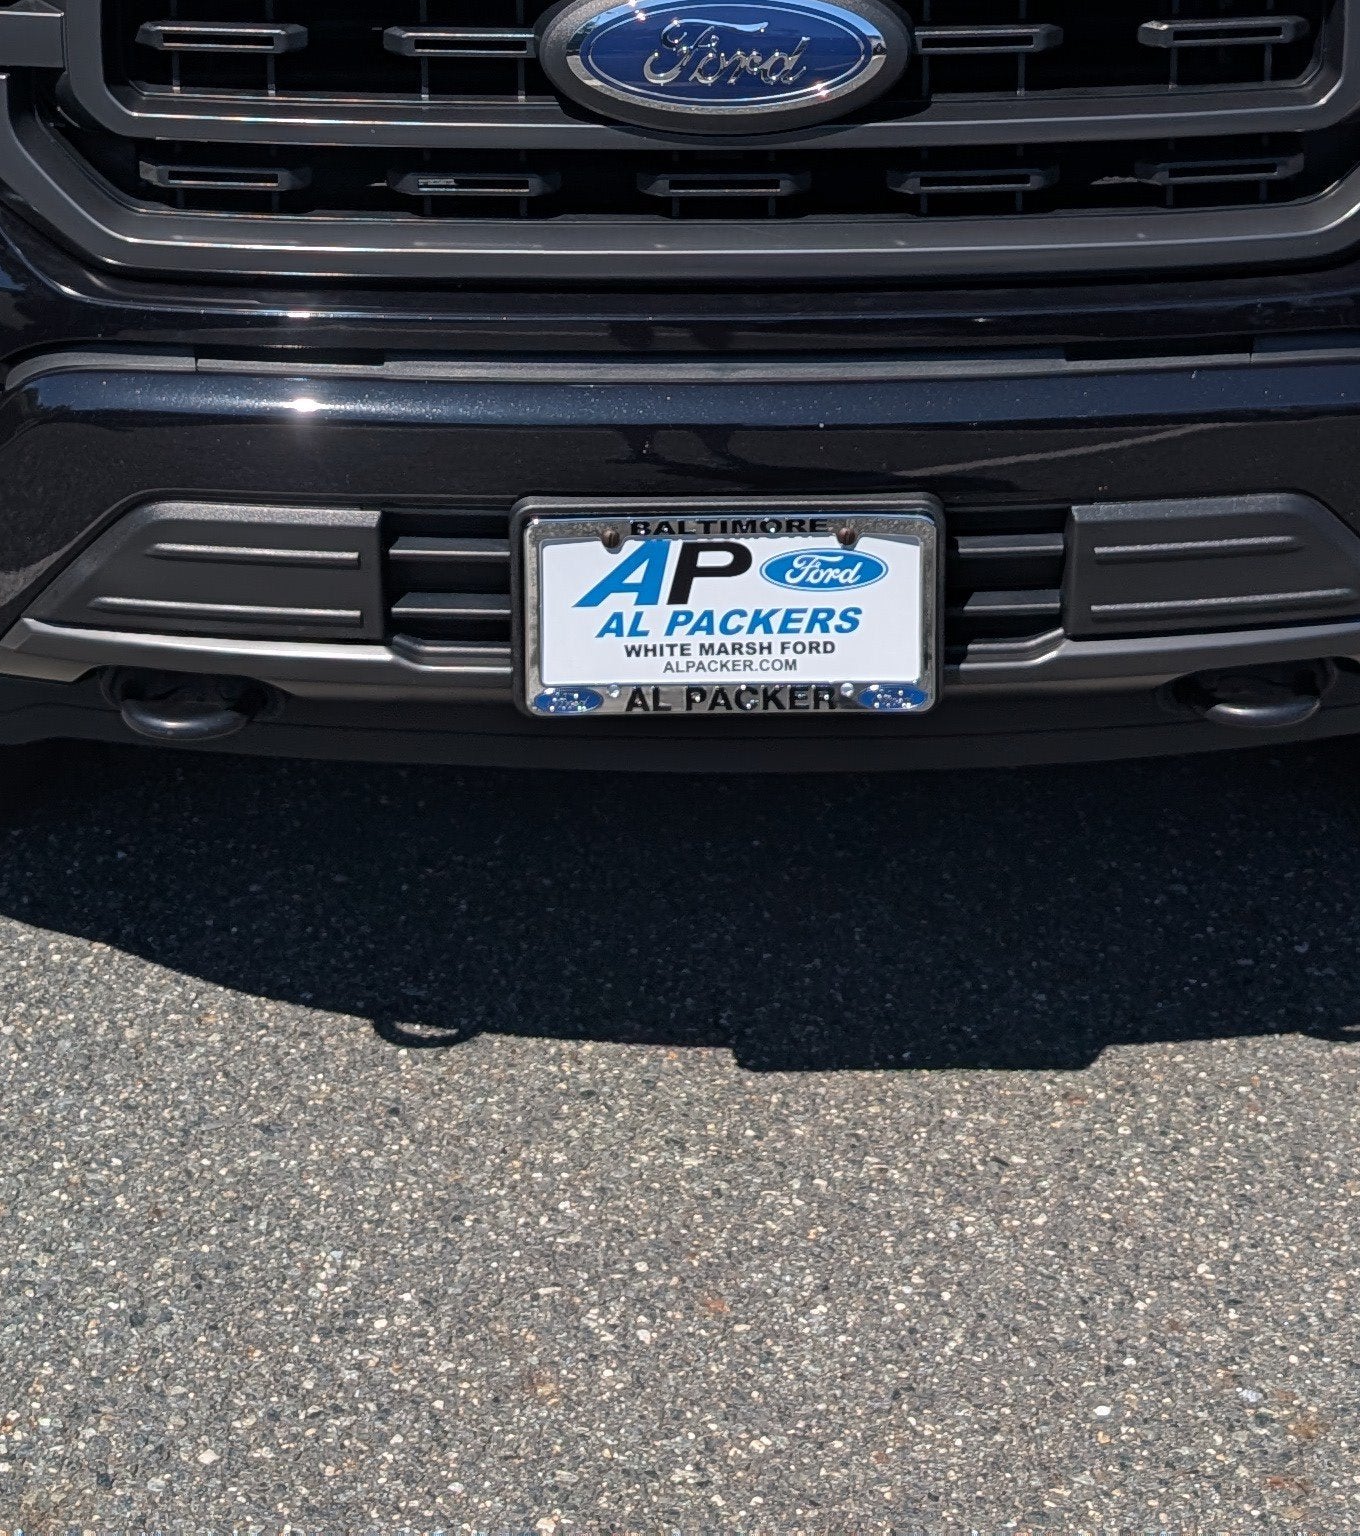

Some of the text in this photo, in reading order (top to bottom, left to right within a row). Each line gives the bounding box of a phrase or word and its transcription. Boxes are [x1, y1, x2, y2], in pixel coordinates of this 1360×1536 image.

[643, 18, 812, 86] Ford
[629, 518, 829, 537] BALTIMORE
[572, 539, 753, 607] AP
[784, 554, 863, 584] Ford
[595, 607, 863, 638] AL PACKERS
[624, 640, 836, 658] WHITE MARSH FORD
[662, 658, 798, 673] ALPACKER.COM
[625, 686, 672, 712] AL
[685, 684, 837, 711] PACKER
